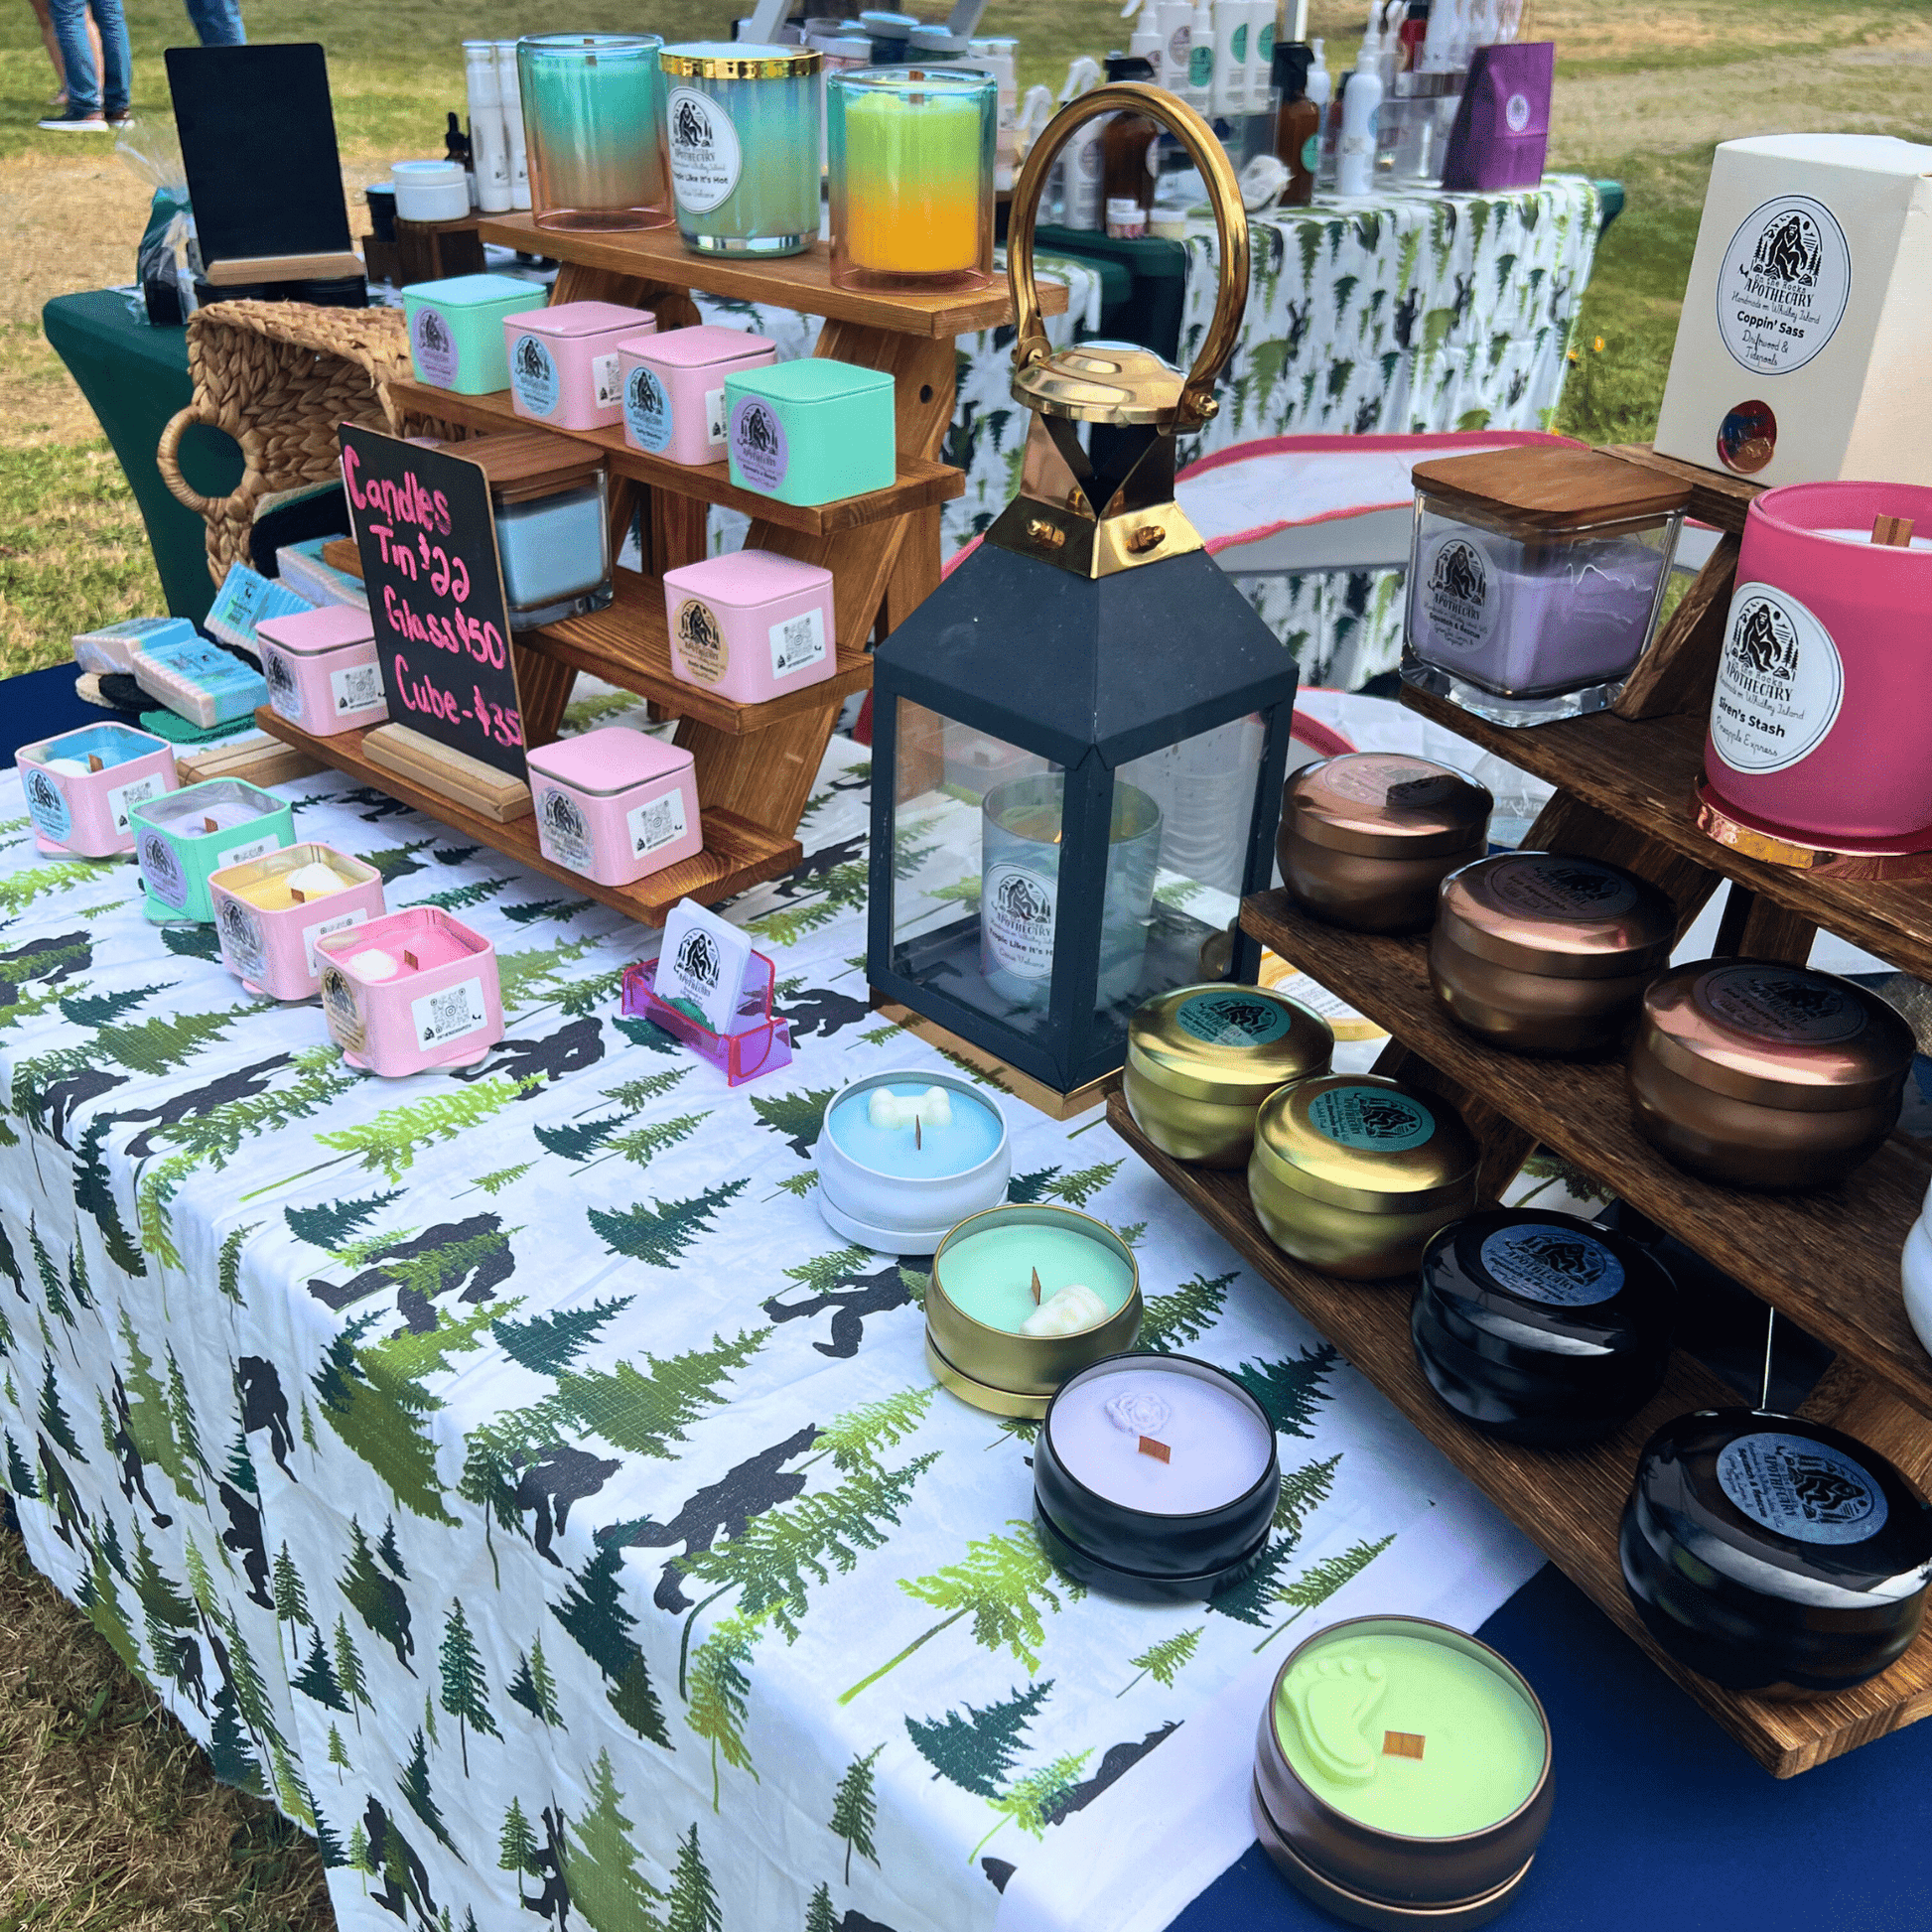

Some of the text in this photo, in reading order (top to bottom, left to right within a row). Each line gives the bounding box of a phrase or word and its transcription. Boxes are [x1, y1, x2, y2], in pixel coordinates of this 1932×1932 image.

[1744, 278, 1815, 307] APOTHECARY
[1754, 274, 1807, 294] On the Rocks
[1731, 290, 1761, 310] Handmade
[1771, 303, 1798, 323] Whidbey
[1799, 310, 1821, 325] Island
[1736, 310, 1805, 339] Coppin' Sass
[1742, 330, 1789, 353] Driftwood &
[1745, 345, 1778, 367] Tidepools
[344, 445, 452, 536] Candles
[369, 524, 471, 604] Tin $22
[383, 585, 505, 669] Glass $50
[1726, 661, 1794, 702] APOTHECARY
[1755, 671, 1784, 688] Rocks
[1719, 696, 1786, 738] Siren's Stash
[1745, 691, 1775, 717] Whidbey
[1777, 703, 1805, 720] Island
[1743, 734, 1778, 757] Express
[997, 912, 1051, 936] APOTHECARY
[1009, 940, 1028, 952] Like
[1029, 946, 1042, 955] It's
[1737, 1448, 1755, 1479] Squatch
[1751, 1489, 1767, 1518] Rescue
[1764, 1453, 1797, 1515] APOTHECARY
